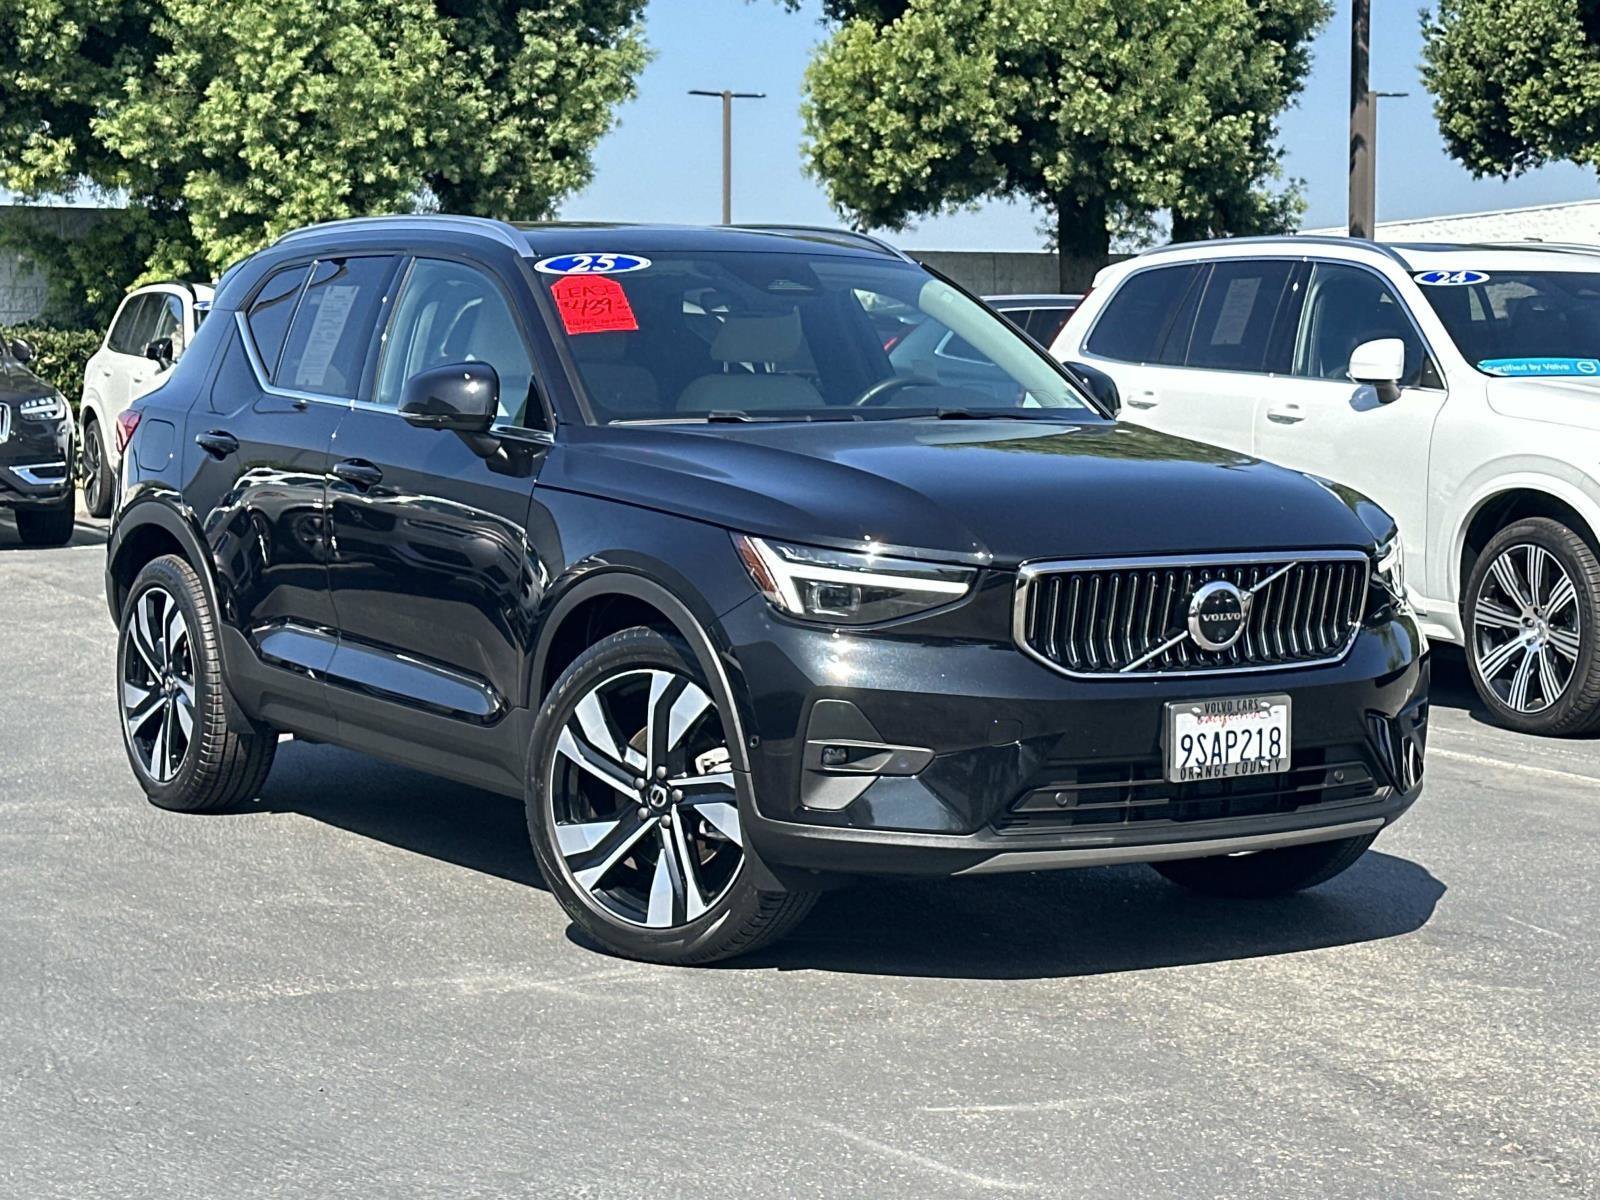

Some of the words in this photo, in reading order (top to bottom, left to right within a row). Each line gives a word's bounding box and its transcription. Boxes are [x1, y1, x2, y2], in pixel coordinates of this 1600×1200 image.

[566, 255, 619, 272] 25
[1434, 270, 1467, 284] 24
[1202, 612, 1241, 622] VOLVO
[1204, 701, 1233, 714] VOLVO
[1236, 698, 1259, 712] CARS
[1180, 726, 1282, 768] 9SAP218
